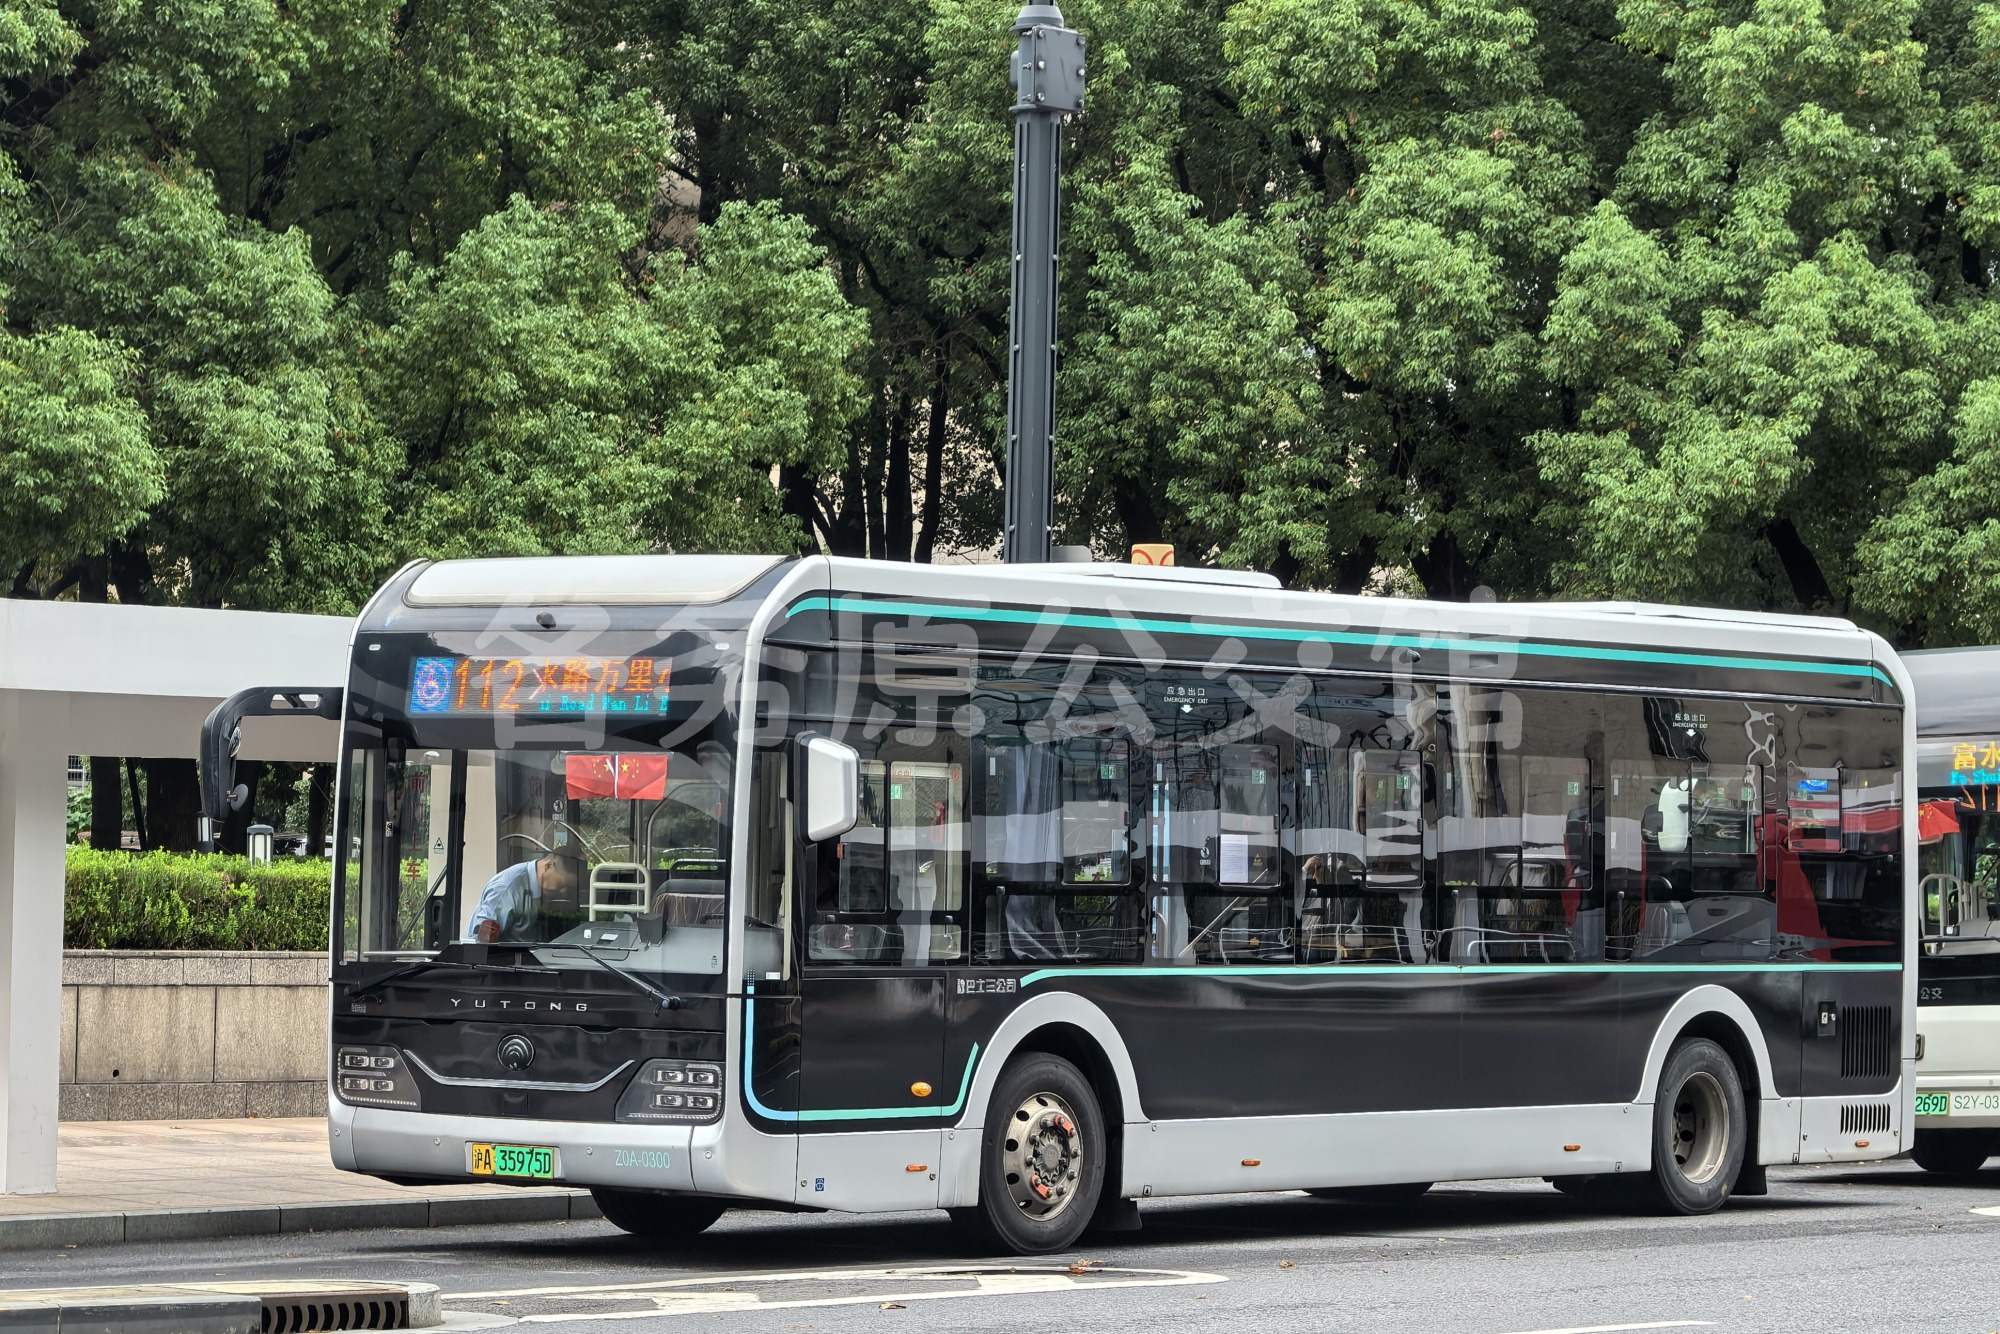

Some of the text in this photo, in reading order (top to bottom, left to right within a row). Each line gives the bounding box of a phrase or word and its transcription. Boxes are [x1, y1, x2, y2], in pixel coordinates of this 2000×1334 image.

[454, 657, 524, 710] 112
[1167, 687, 1205, 697] 应急出口
[560, 694, 594, 711] Road
[634, 694, 650, 711] Li
[1675, 713, 1706, 722] 应急出口
[1953, 741, 2000, 770] 富水
[1920, 987, 1943, 1000] 公交
[450, 998, 588, 1011] YUTONG
[1954, 1095, 2000, 1110] S2Y-03
[498, 1149, 552, 1175] 35975D
[614, 1149, 671, 1169] Z0A-0300
